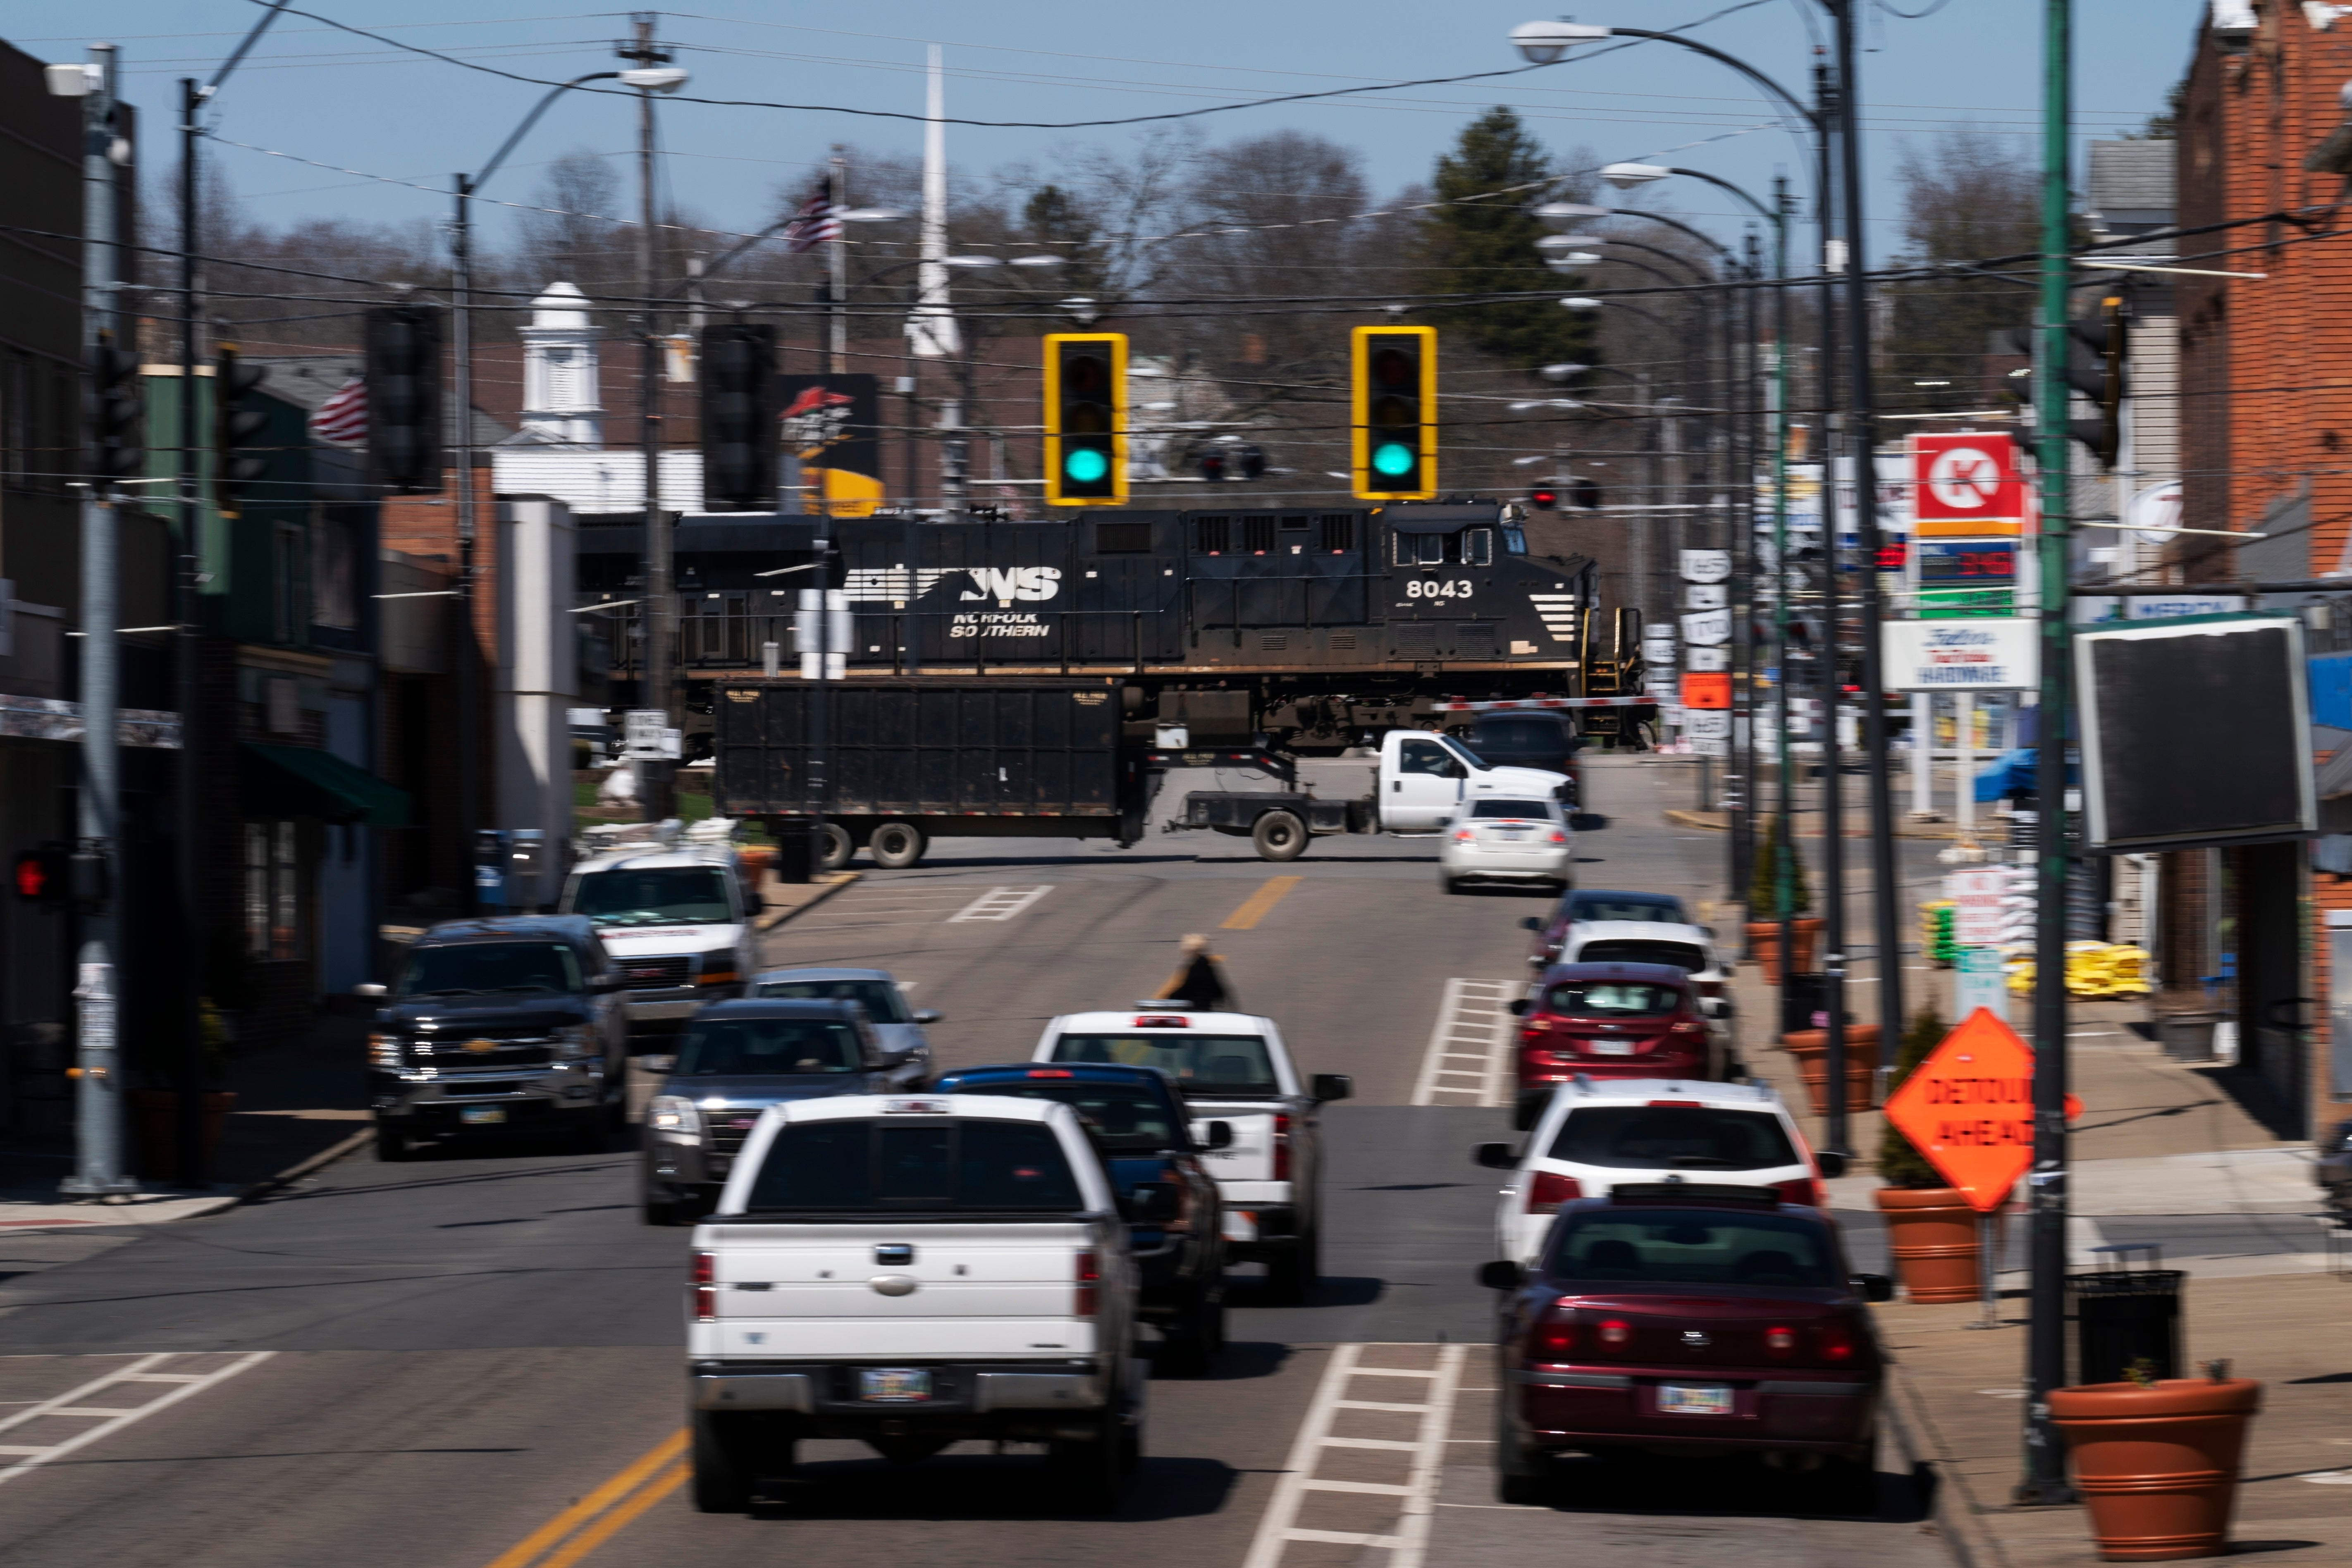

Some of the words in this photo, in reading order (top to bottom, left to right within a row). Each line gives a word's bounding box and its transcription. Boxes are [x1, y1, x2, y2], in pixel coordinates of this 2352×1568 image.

[1406, 580, 1473, 598] 8043
[953, 611, 1038, 624] NORFOLK
[1925, 1078, 2034, 1104] DETOU
